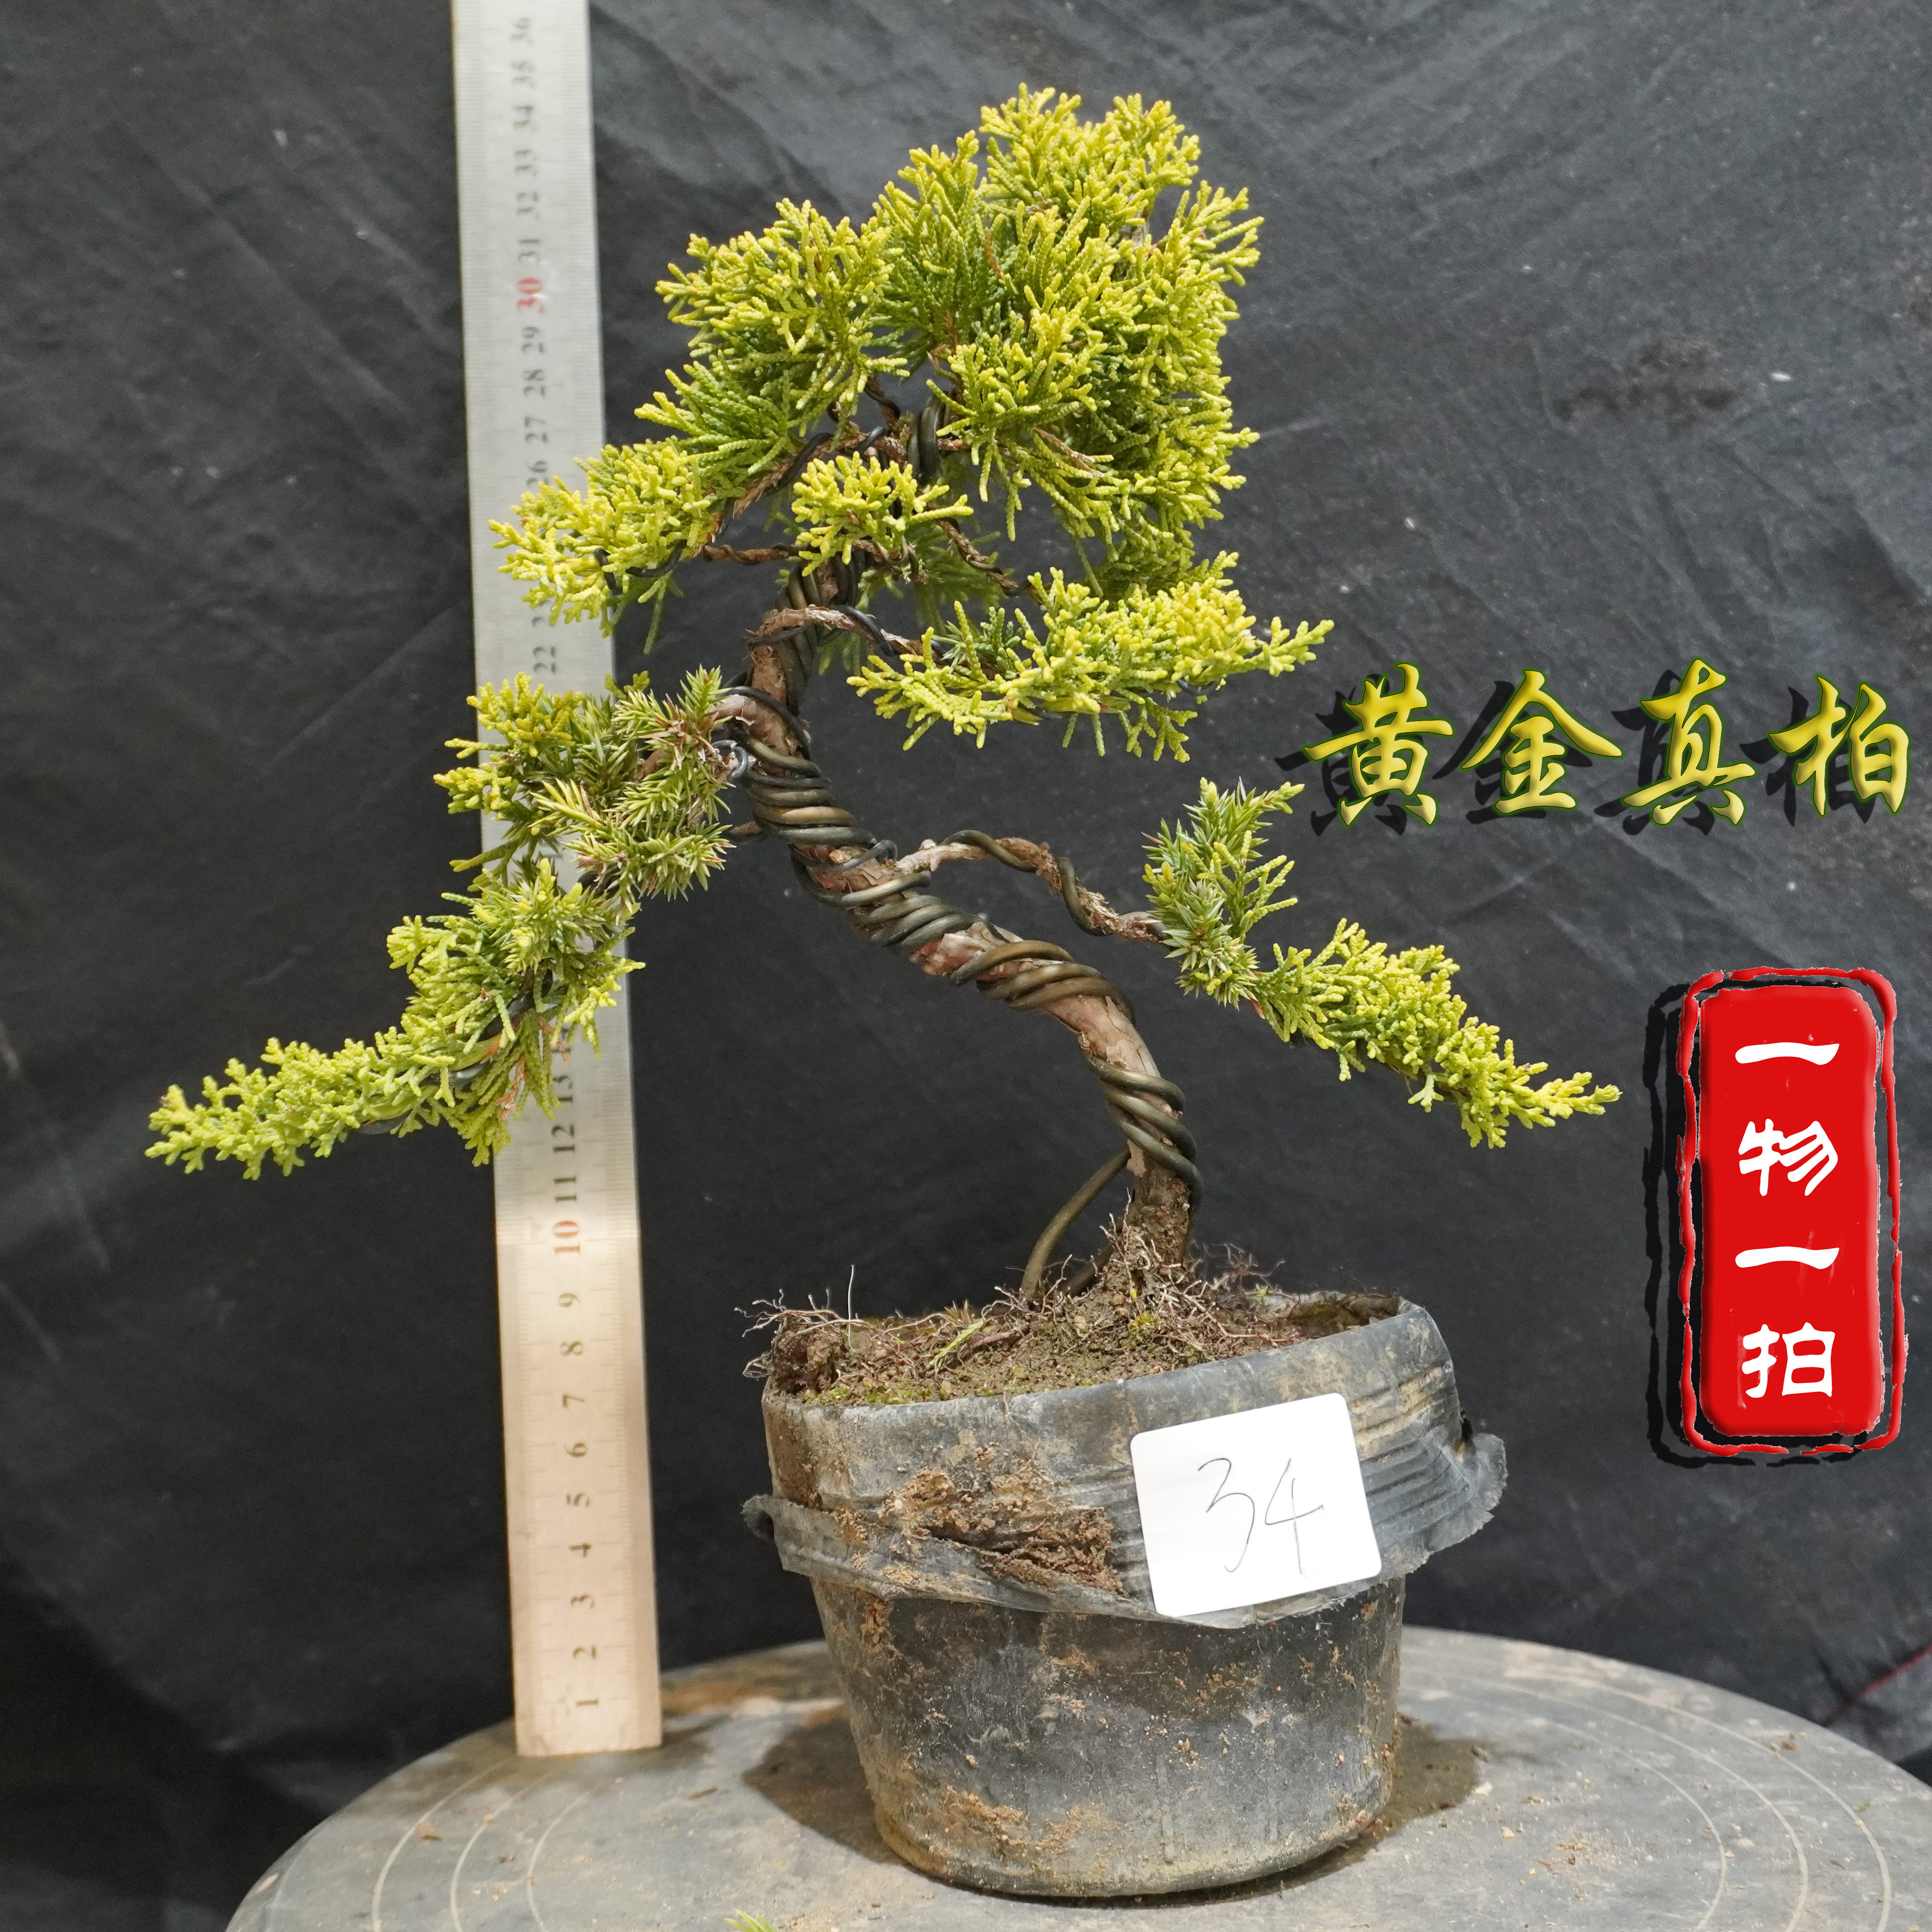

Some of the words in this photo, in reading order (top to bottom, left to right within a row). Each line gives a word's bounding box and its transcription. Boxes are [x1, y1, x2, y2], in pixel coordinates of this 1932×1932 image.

[510, 17, 532, 45] 36
[511, 60, 534, 88] 35
[513, 104, 534, 131] 34
[514, 149, 538, 176] 33
[516, 193, 540, 219] 32
[518, 238, 540, 263] 31
[517, 277, 546, 313] 30
[522, 327, 545, 354] 29
[523, 369, 546, 397] 28
[525, 416, 548, 443] 27
[533, 645, 556, 674] 22
[551, 1123, 575, 1153] 12
[554, 1176, 577, 1202] 11
[552, 1220, 580, 1255] 10
[557, 1293, 580, 1308] 9
[559, 1341, 583, 1357] 8
[562, 1394, 585, 1408] 7
[564, 1442, 588, 1458] 6
[566, 1493, 590, 1507] 5
[1197, 1458, 1324, 1576] 34
[568, 1543, 592, 1558] 4
[570, 1594, 595, 1609] 3
[572, 1645, 597, 1660] 2
[576, 1697, 599, 1706] 1
